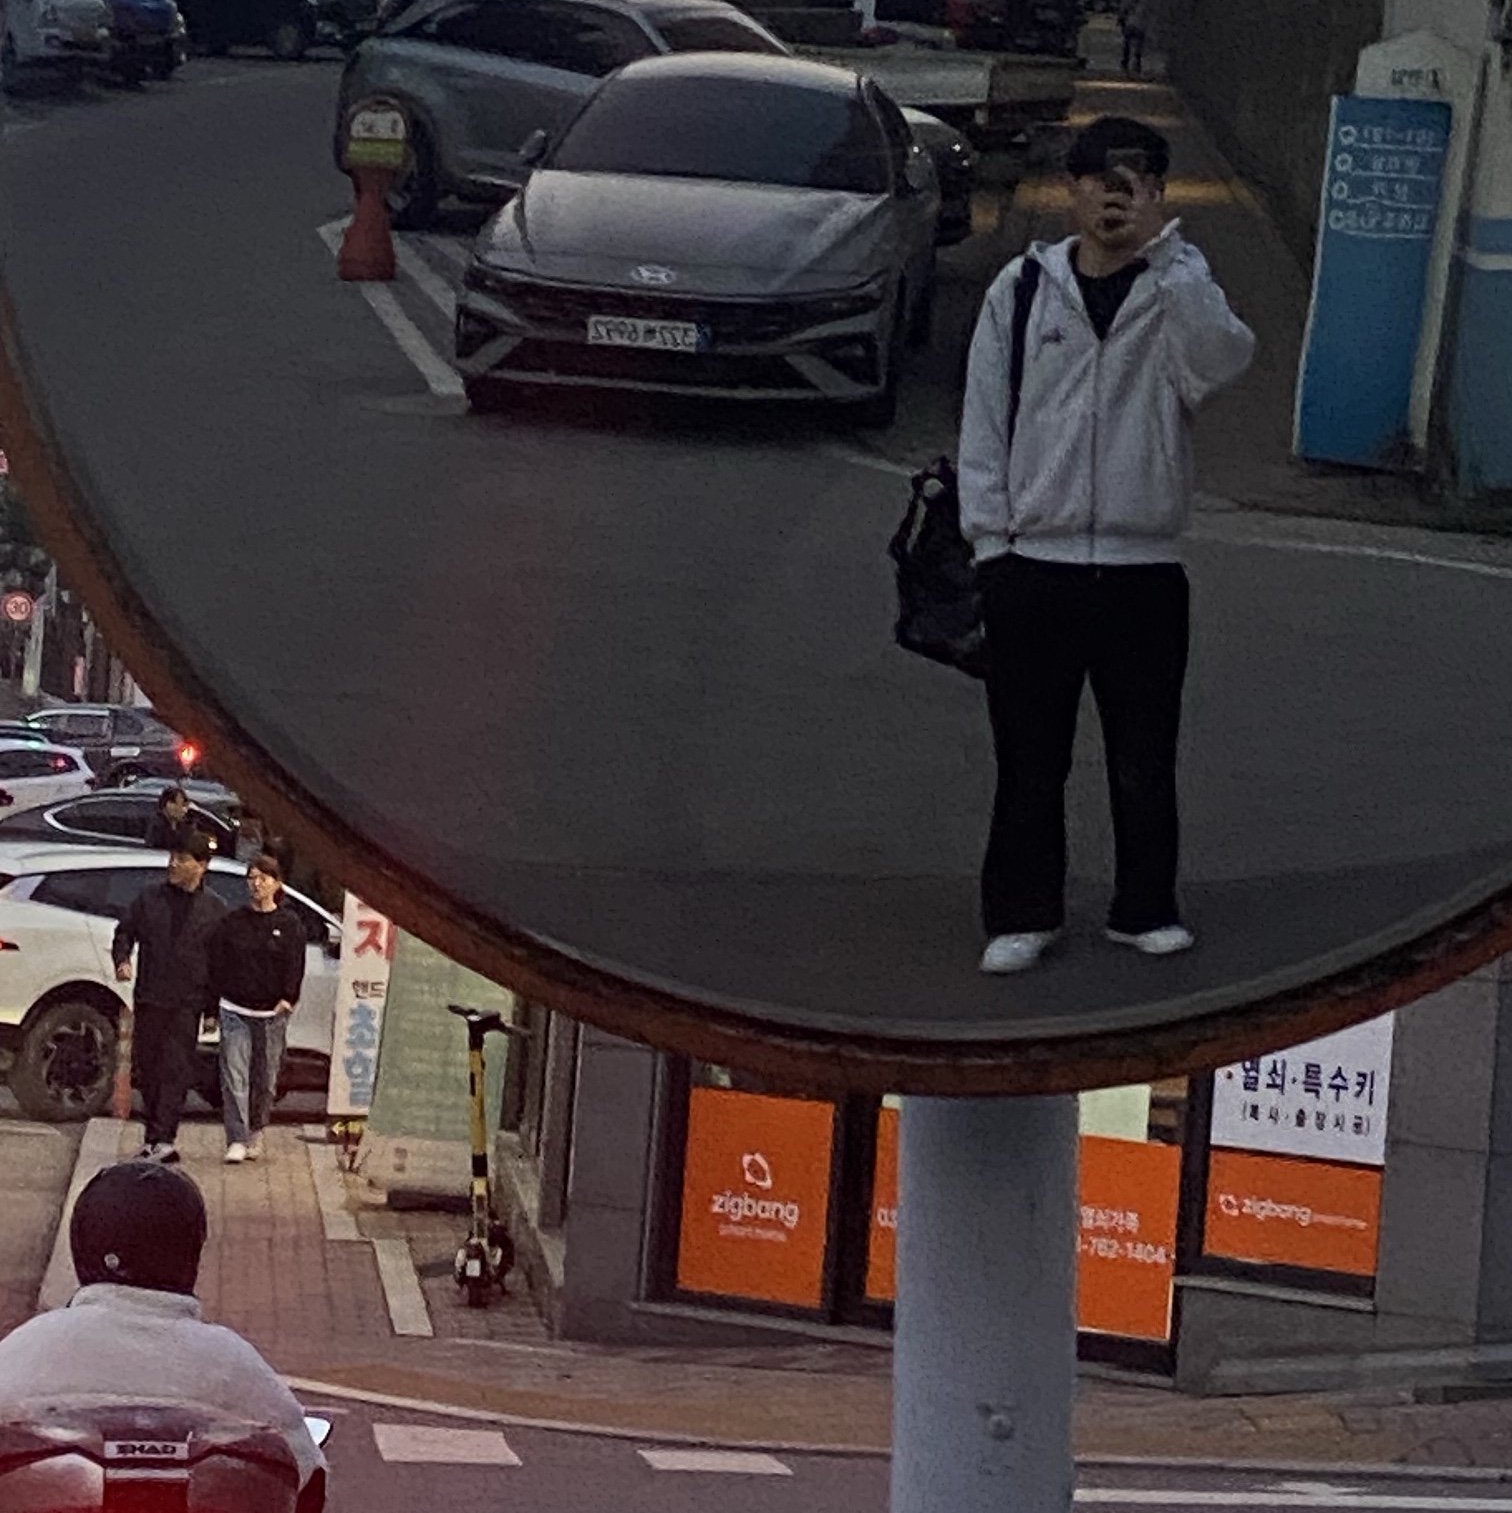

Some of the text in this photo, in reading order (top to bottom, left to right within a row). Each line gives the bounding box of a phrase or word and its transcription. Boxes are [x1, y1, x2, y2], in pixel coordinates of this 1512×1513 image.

[12, 600, 28, 614] 30
[711, 1189, 800, 1229] zigbang
[1241, 1194, 1313, 1227] zigbang
